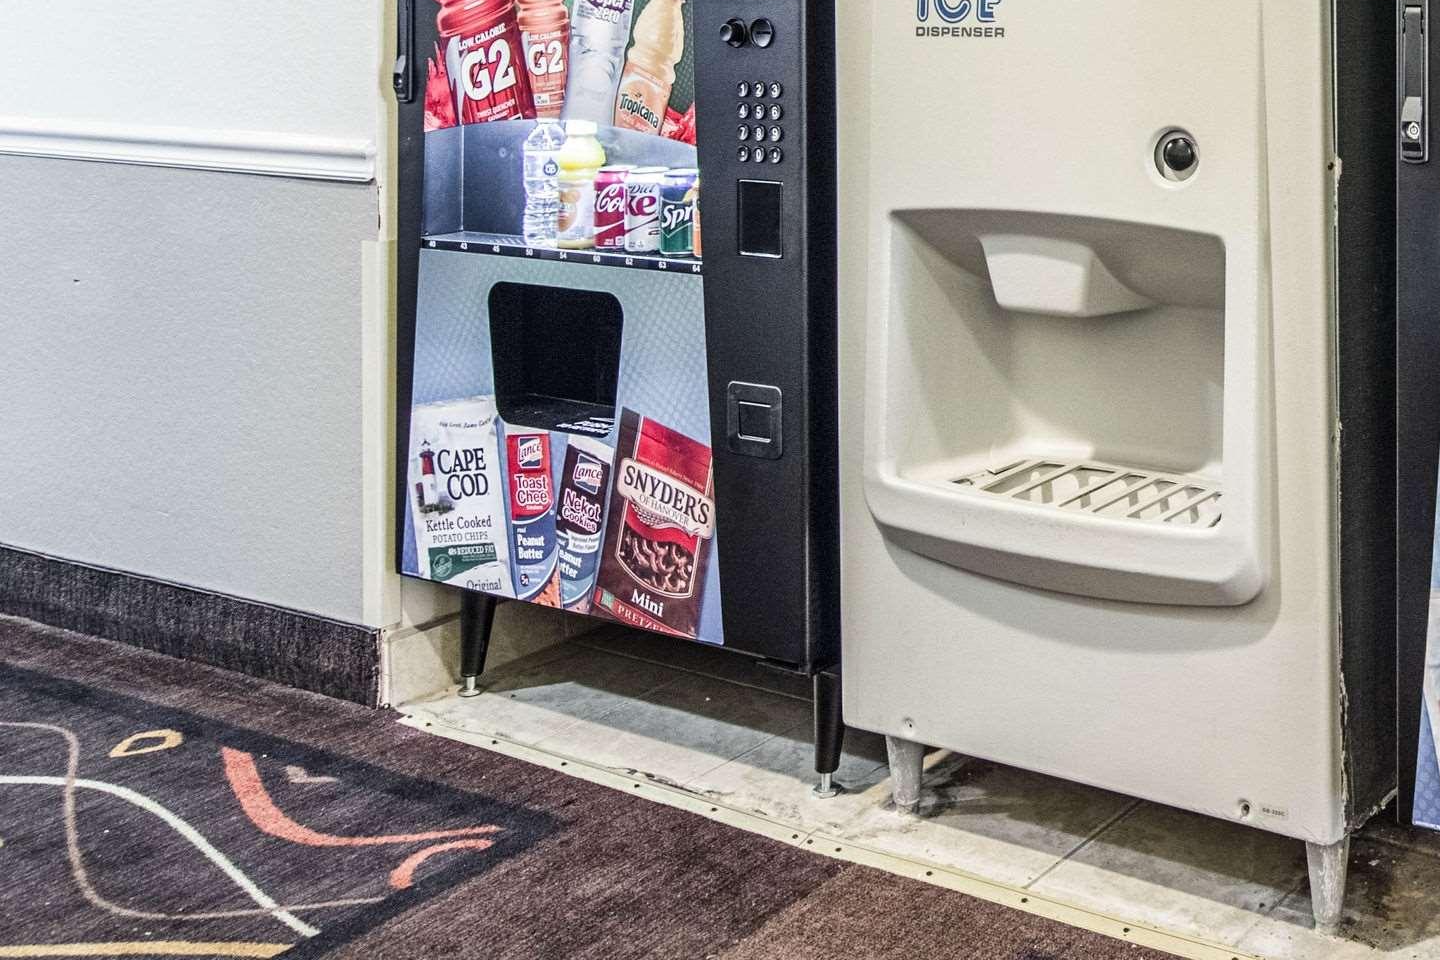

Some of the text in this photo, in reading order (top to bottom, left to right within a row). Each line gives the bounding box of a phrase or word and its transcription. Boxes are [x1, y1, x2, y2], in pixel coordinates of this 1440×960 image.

[595, 6, 620, 24] zero
[459, 23, 507, 50] LOW CALORIE
[916, 26, 1005, 38] DISPENSER
[462, 38, 517, 101] G2
[528, 40, 564, 76] G2
[619, 92, 659, 129] Tropicana
[626, 195, 657, 217] ke
[661, 203, 693, 230] Spr
[428, 240, 701, 272] 40 43 45 50 54 60 62 63 64
[437, 447, 487, 475] CAPE
[574, 463, 603, 480] Lance
[447, 473, 489, 500] COD
[514, 473, 549, 490] Toast
[624, 464, 710, 525] SNYDER'S
[516, 489, 549, 506] Chee
[563, 488, 602, 522] Nekot
[426, 515, 492, 532] Kettle Cooked
[562, 505, 598, 532] Cookies
[652, 501, 690, 526] HANOVER
[433, 531, 488, 543] POTATO CHIPS
[517, 534, 544, 546] Peanut
[518, 547, 544, 559] Butter
[560, 549, 582, 568] eanut
[466, 578, 502, 591] Original
[631, 588, 664, 617] Mini
[617, 605, 663, 632] PRETZE
